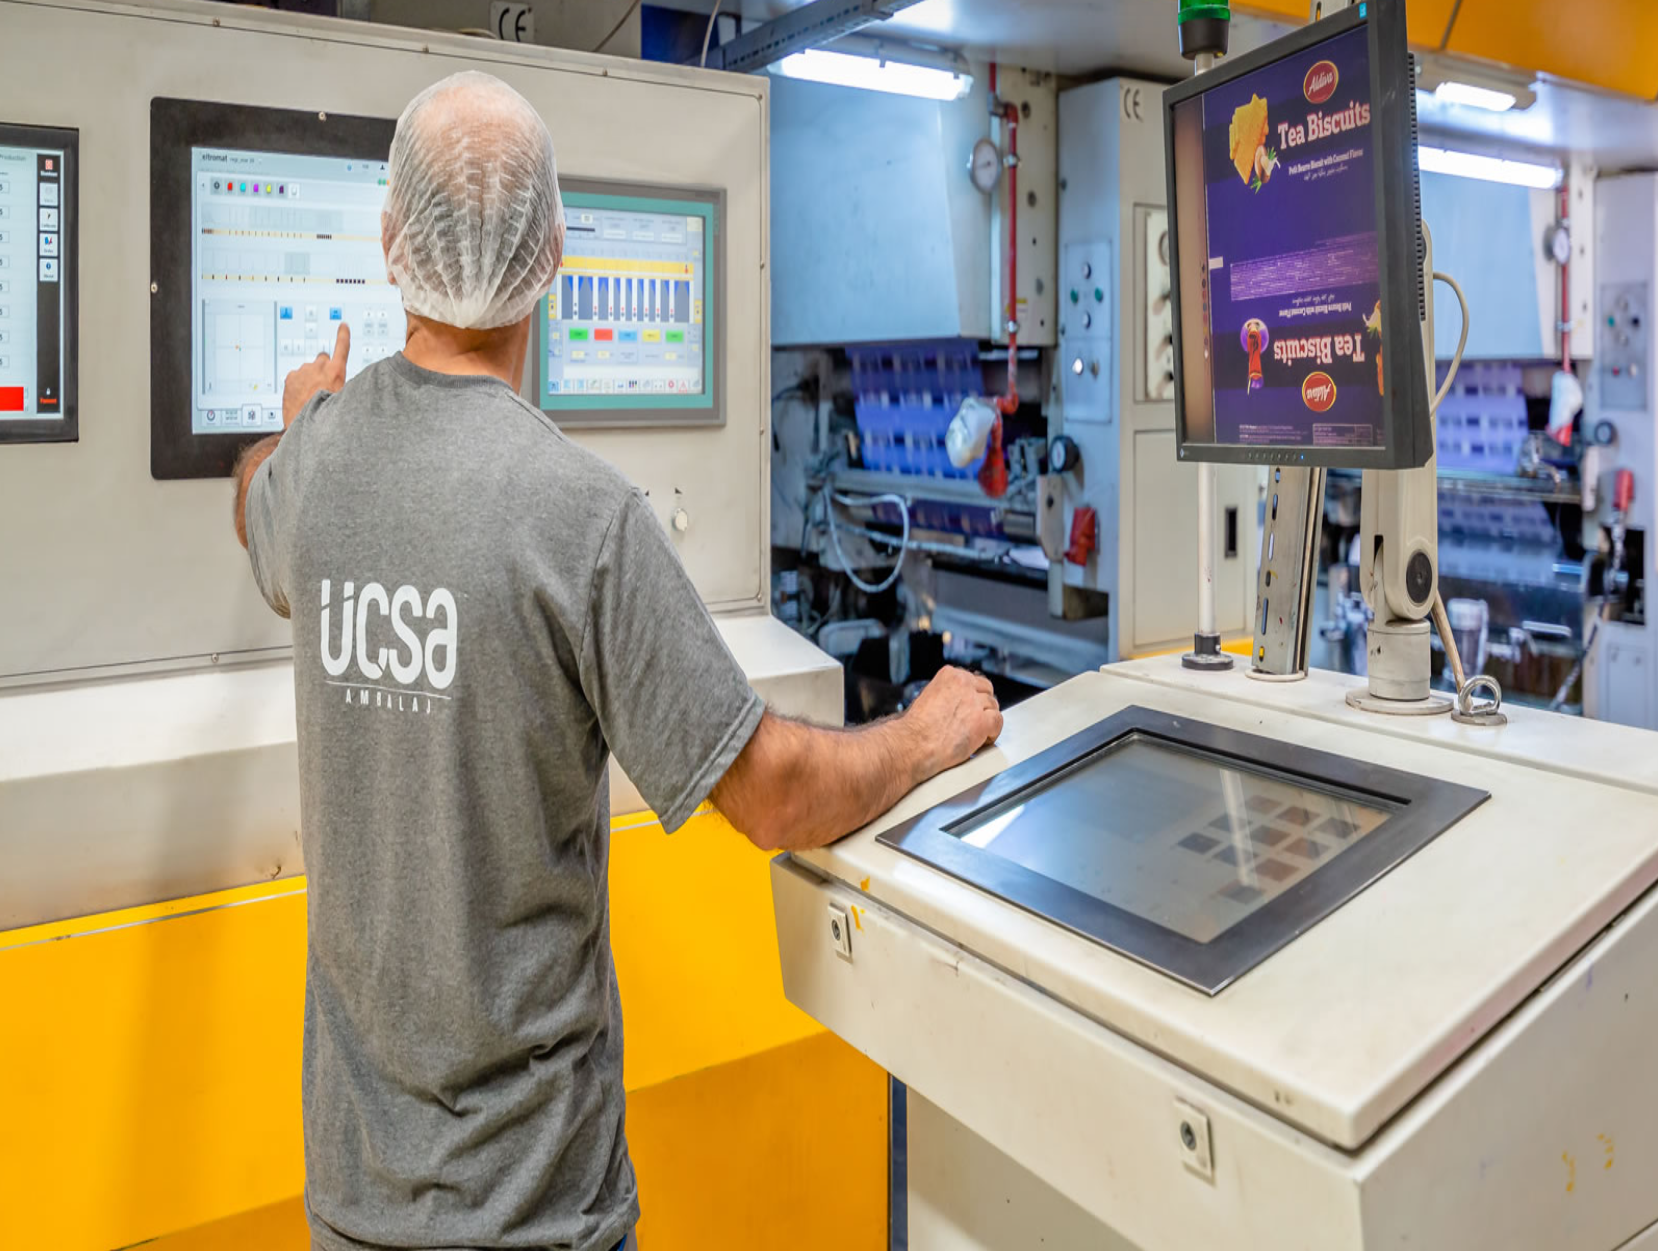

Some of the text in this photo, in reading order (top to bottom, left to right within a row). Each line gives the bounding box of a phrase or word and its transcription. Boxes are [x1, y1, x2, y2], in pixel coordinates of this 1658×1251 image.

[1278, 100, 1371, 149] Tea Biscuits
[1273, 333, 1365, 366] Tea Biscuits
[345, 688, 431, 714] AMBALAJ
